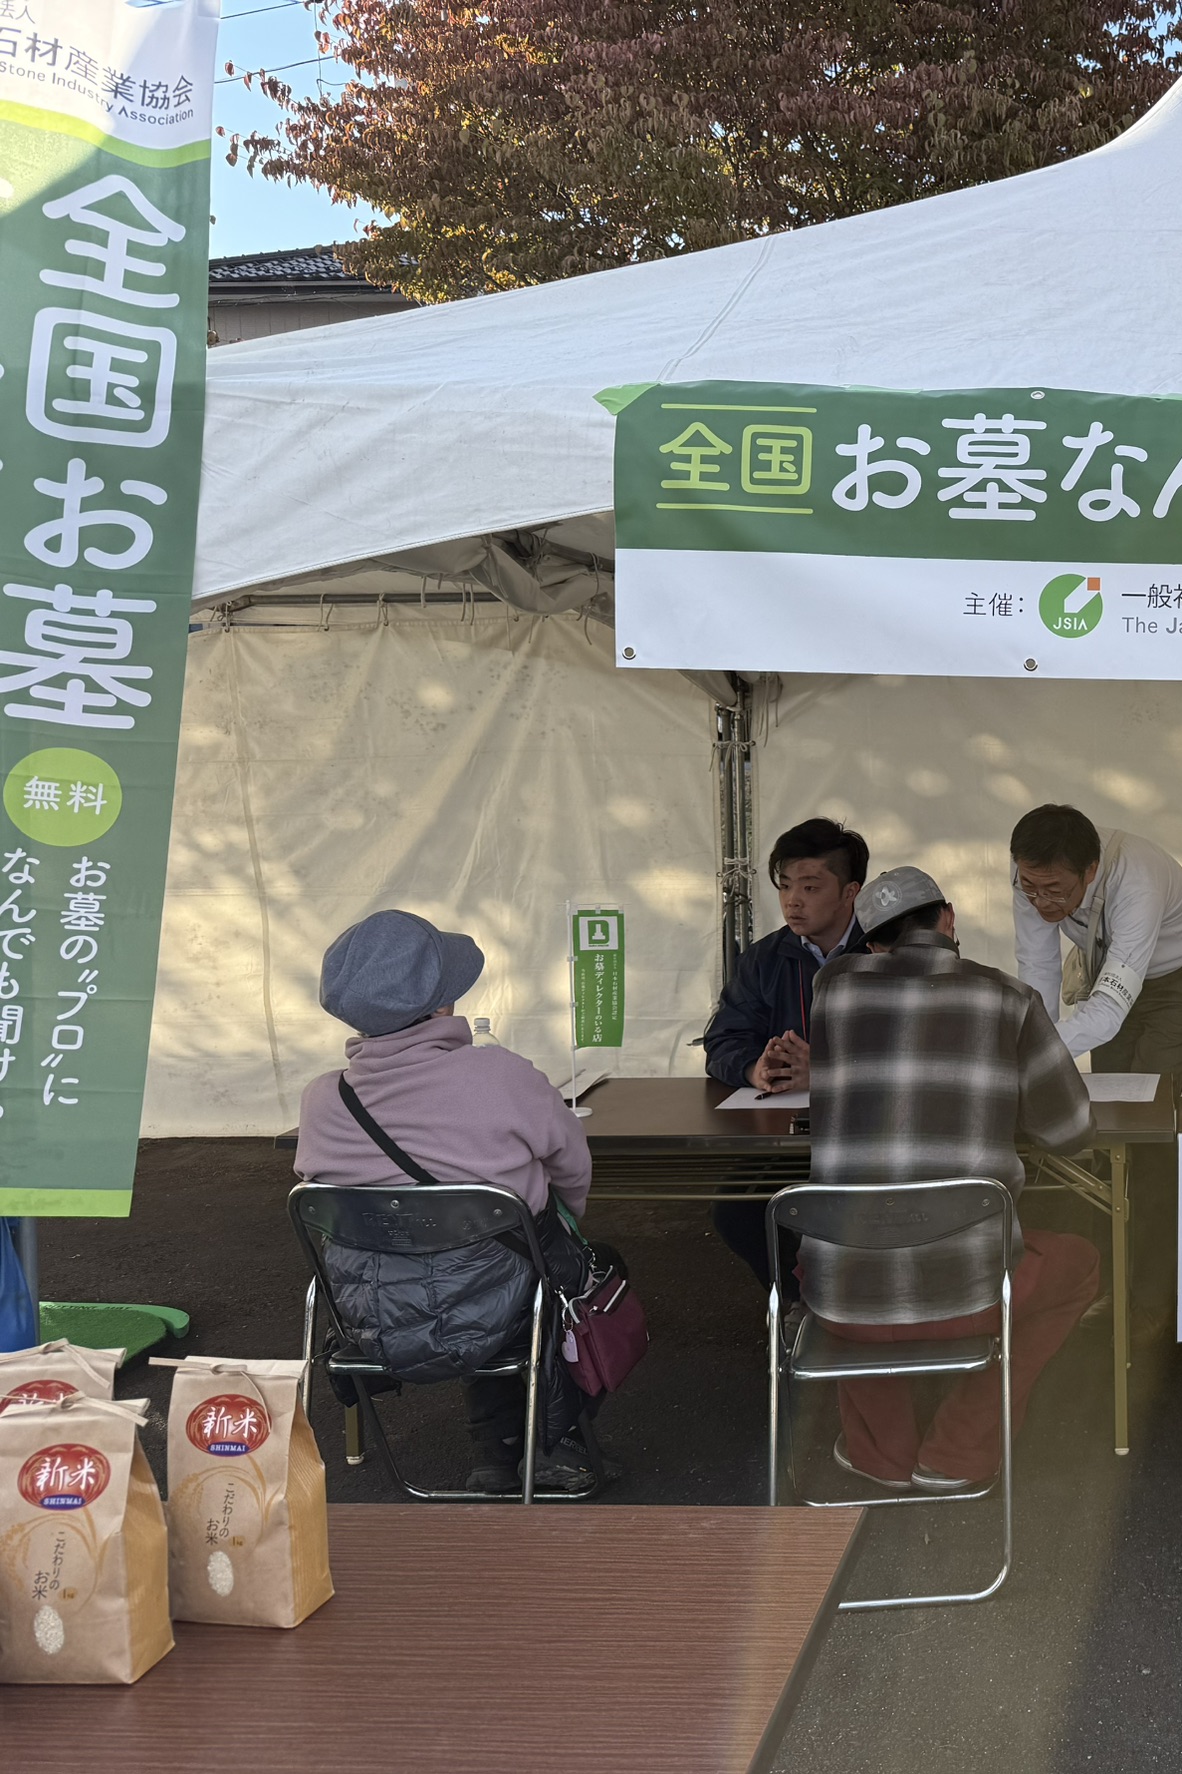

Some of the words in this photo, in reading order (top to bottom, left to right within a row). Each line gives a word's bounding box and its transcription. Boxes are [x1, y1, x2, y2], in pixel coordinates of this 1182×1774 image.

[52, 72, 114, 112] Industry
[0, 174, 186, 730] 全国お墓
[659, 421, 813, 494] 全国
[1053, 617, 1088, 631] JSIA
[1122, 617, 1158, 634] The
[23, 776, 107, 815] 無料
[202, 1406, 257, 1438] 新米
[210, 1444, 246, 1452] SHINMAI
[36, 1457, 96, 1491] 新米
[43, 1497, 82, 1505] SHINMAI
[219, 1482, 235, 1538] こだわりの
[205, 1519, 220, 1546] お米
[49, 1532, 65, 1590] こだわりの
[32, 1570, 50, 1600] お米
